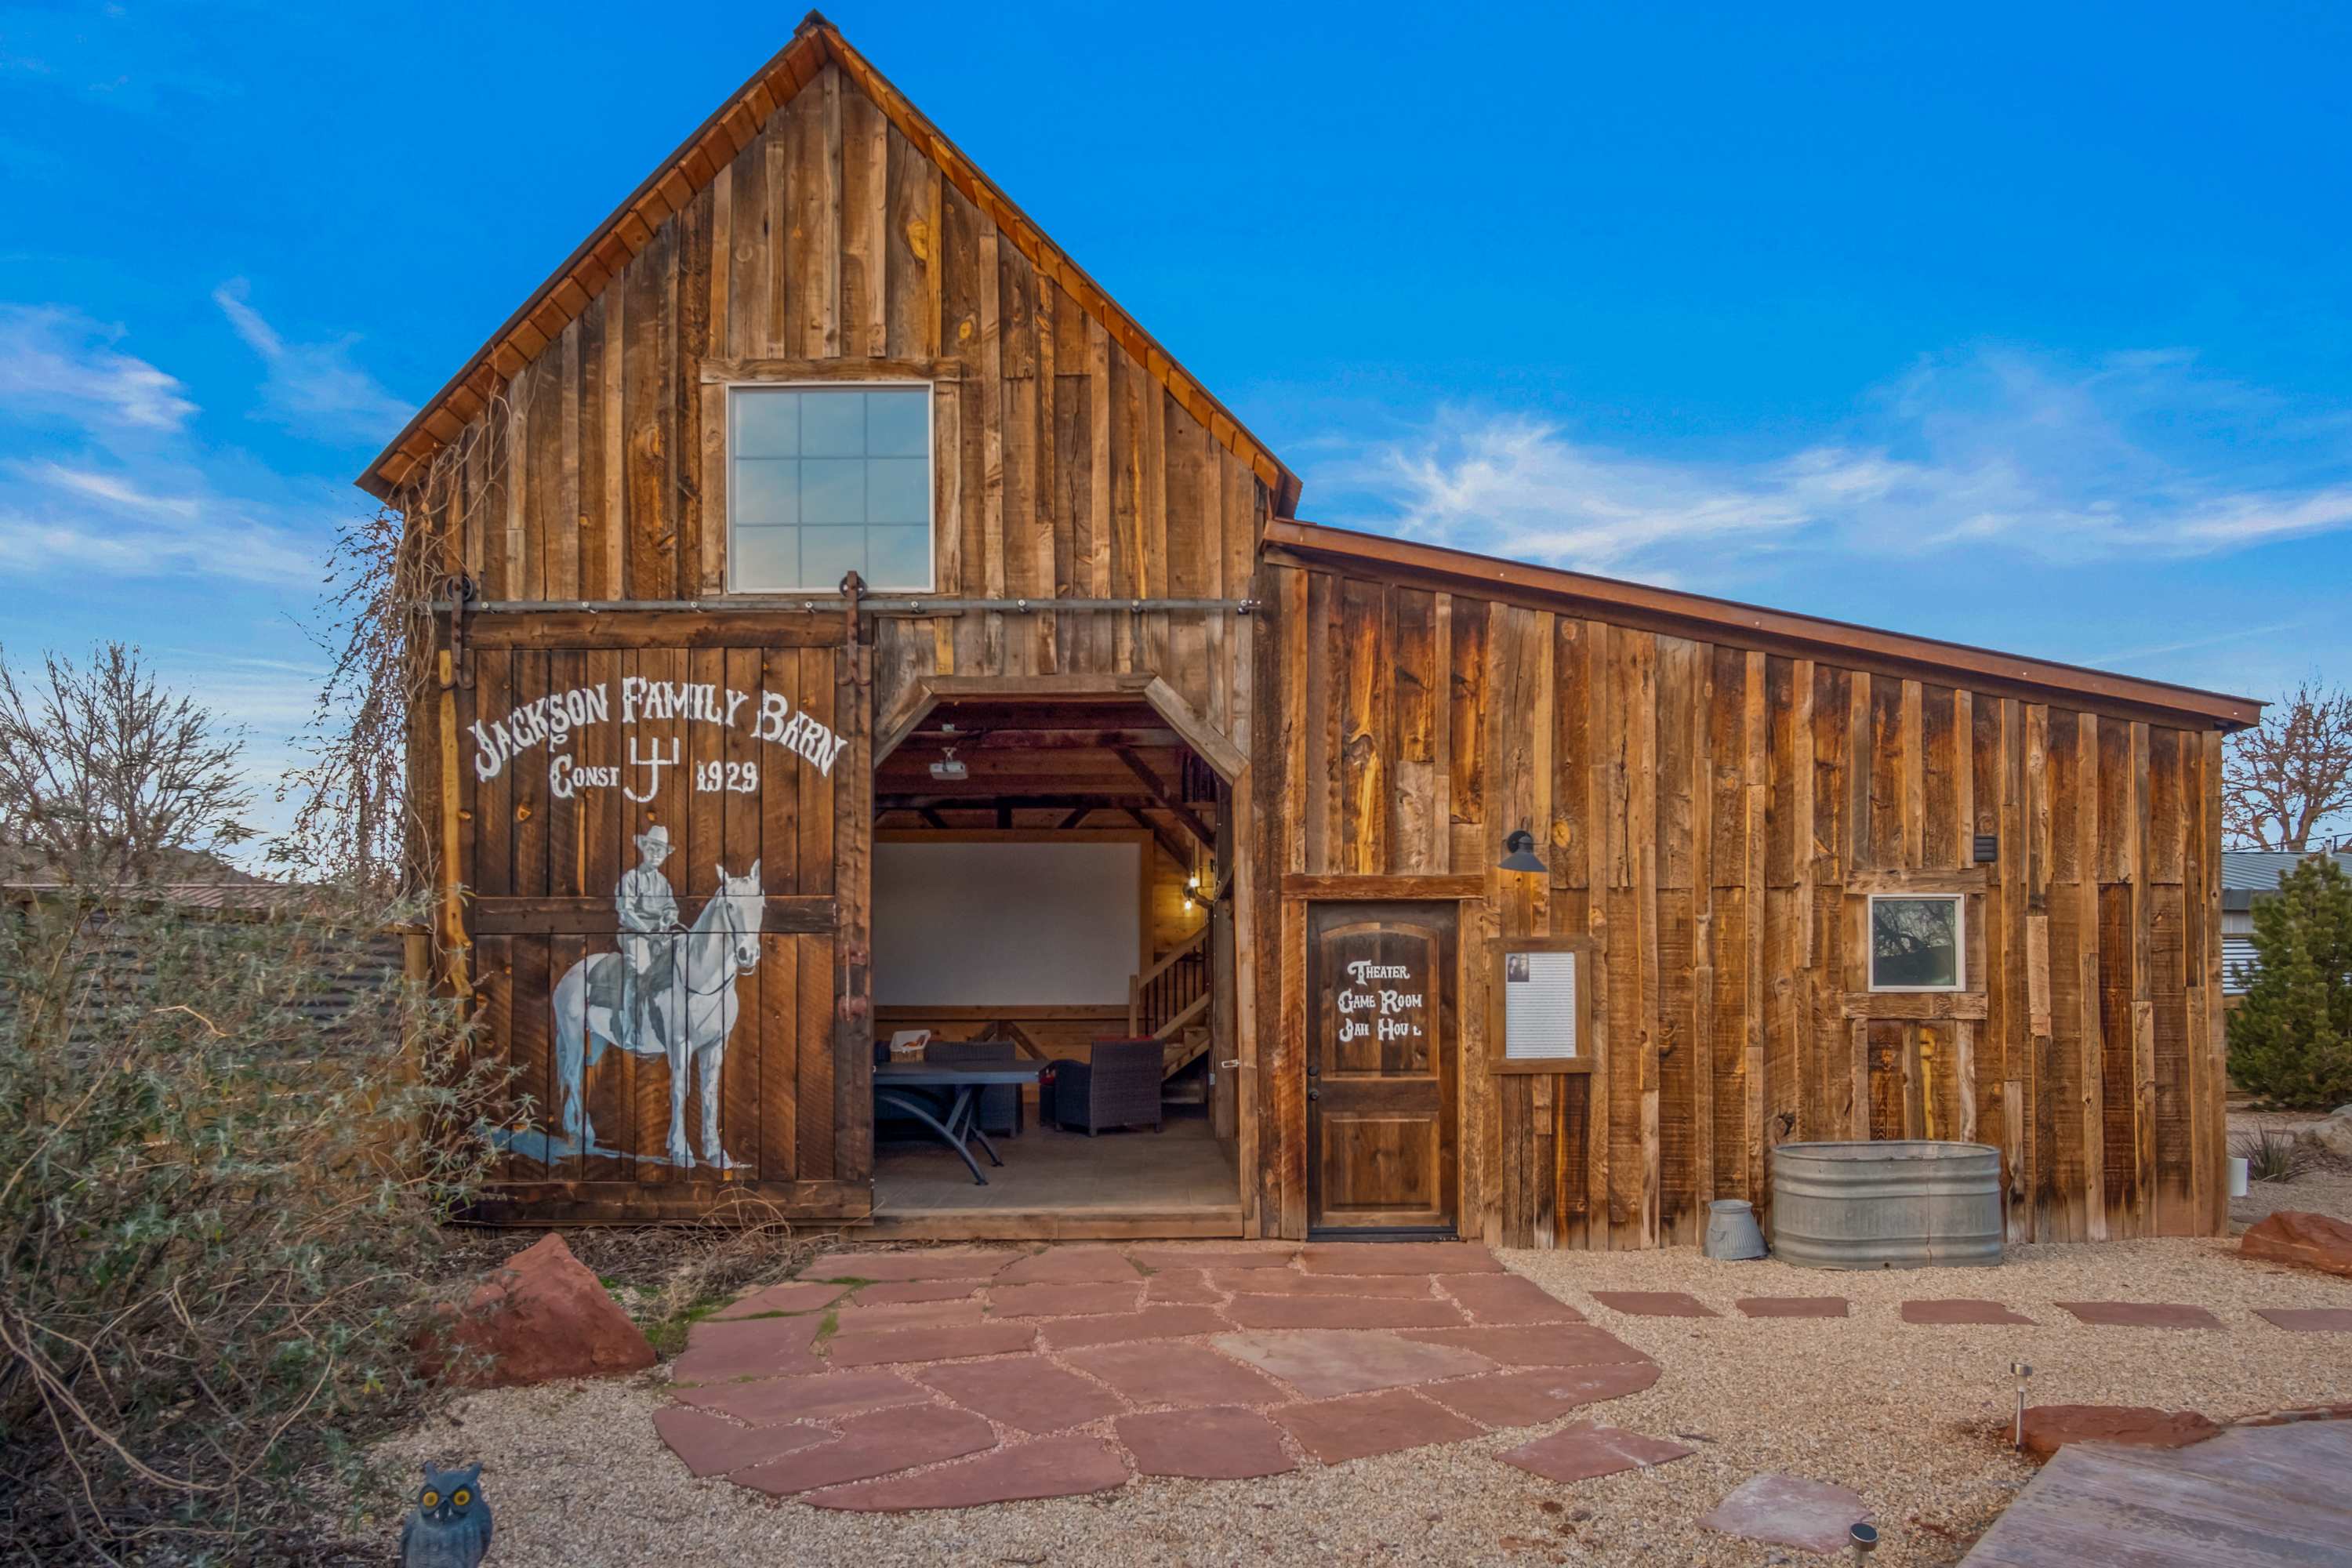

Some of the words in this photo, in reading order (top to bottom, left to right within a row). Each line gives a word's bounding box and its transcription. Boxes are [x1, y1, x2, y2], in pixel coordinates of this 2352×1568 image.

[467, 684, 609, 782] JACKSON
[622, 676, 750, 728] FAMILY
[750, 690, 848, 777] BARN
[695, 760, 760, 793] 1929
[1347, 959, 1410, 985] THEATER
[1338, 988, 1377, 1014] GAME
[1377, 989, 1422, 1014] ROOM
